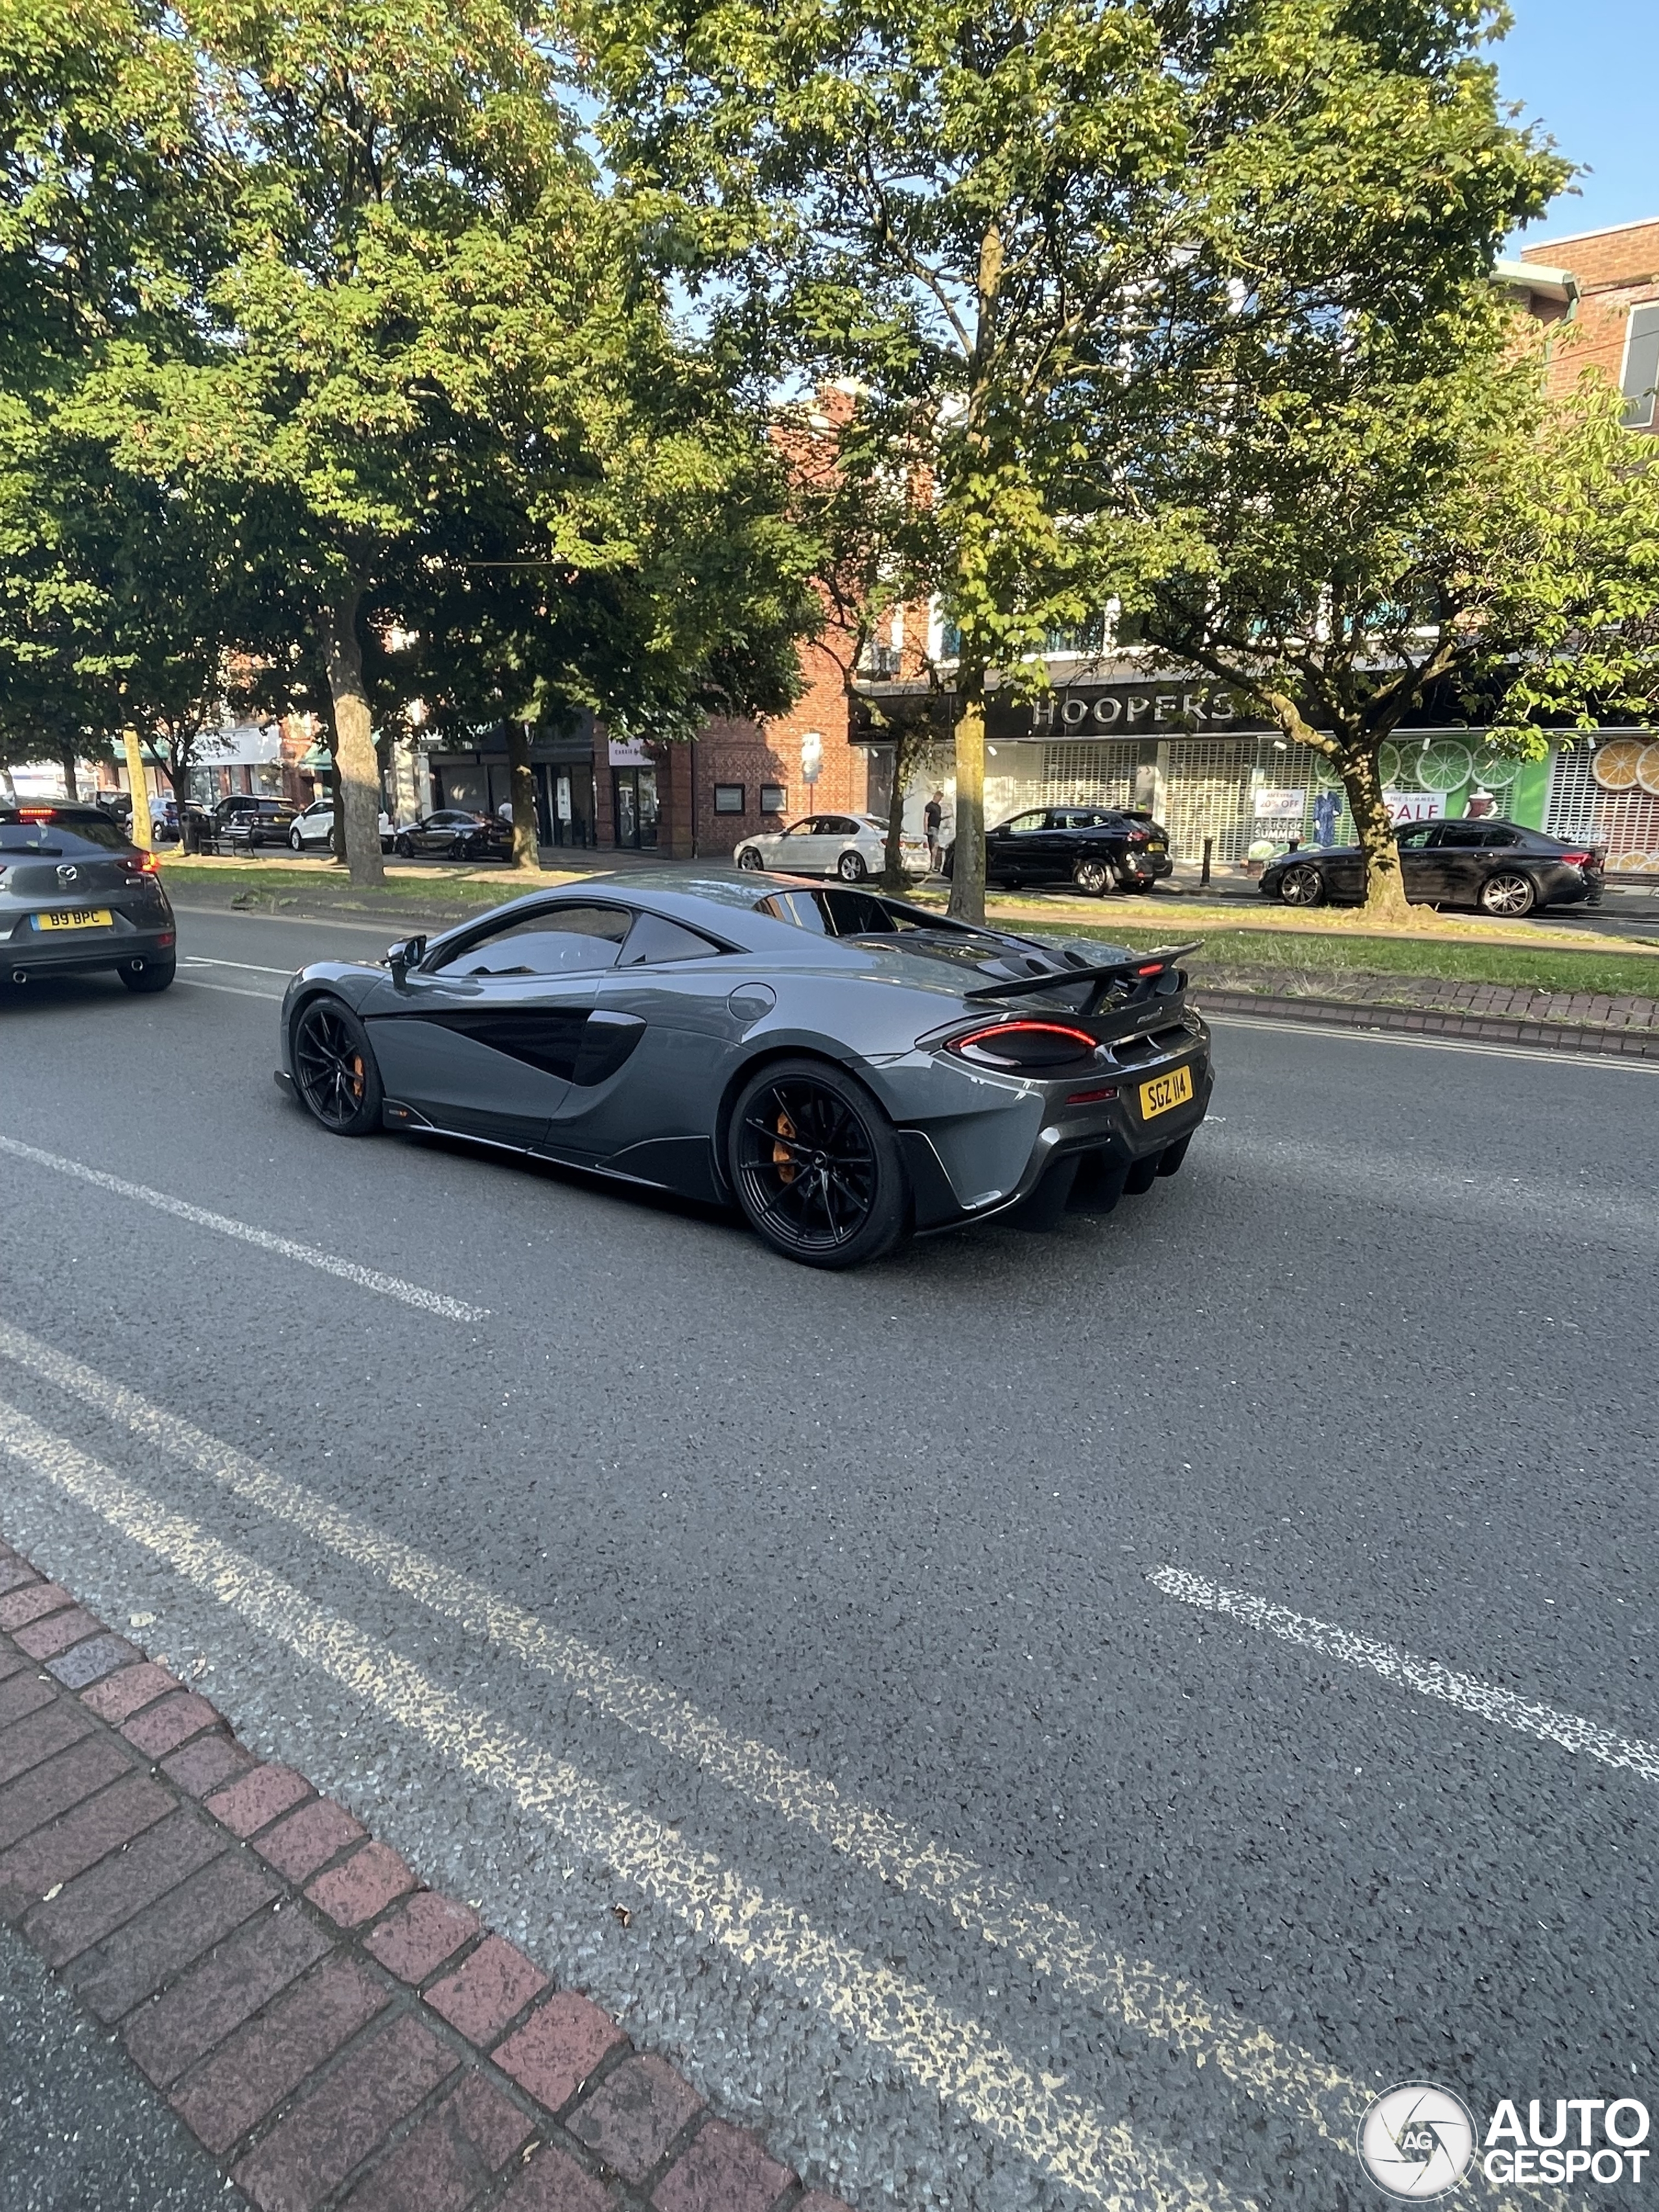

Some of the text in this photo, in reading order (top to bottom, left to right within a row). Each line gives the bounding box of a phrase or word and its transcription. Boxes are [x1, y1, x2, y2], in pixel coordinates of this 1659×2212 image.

[1032, 692, 1234, 725] HOOPERS
[1281, 800, 1299, 808] OFF
[1385, 804, 1439, 821] SALE
[1254, 830, 1301, 840] SUMMER
[50, 911, 100, 926] B9 BPC
[1148, 1073, 1186, 1112] SGZ 114
